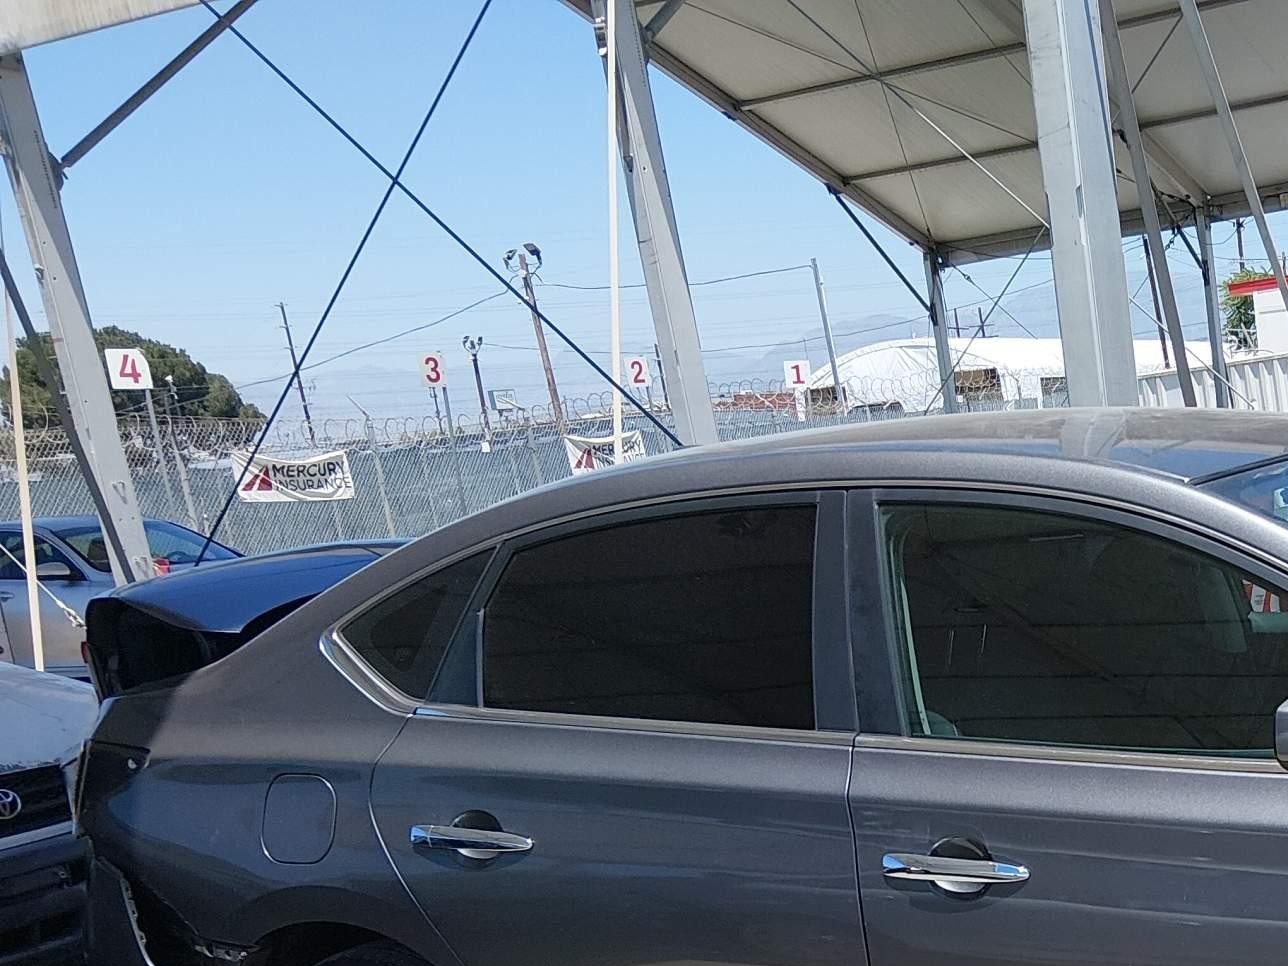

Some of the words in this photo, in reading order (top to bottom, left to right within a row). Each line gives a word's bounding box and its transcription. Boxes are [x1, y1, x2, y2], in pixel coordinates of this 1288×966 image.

[119, 354, 142, 384] 4
[424, 356, 441, 384] 3
[631, 360, 646, 384] 2
[791, 364, 805, 385] 1
[592, 439, 641, 455] MERURY
[271, 460, 345, 478] MERCURY
[274, 476, 352, 492] INSURANCE
